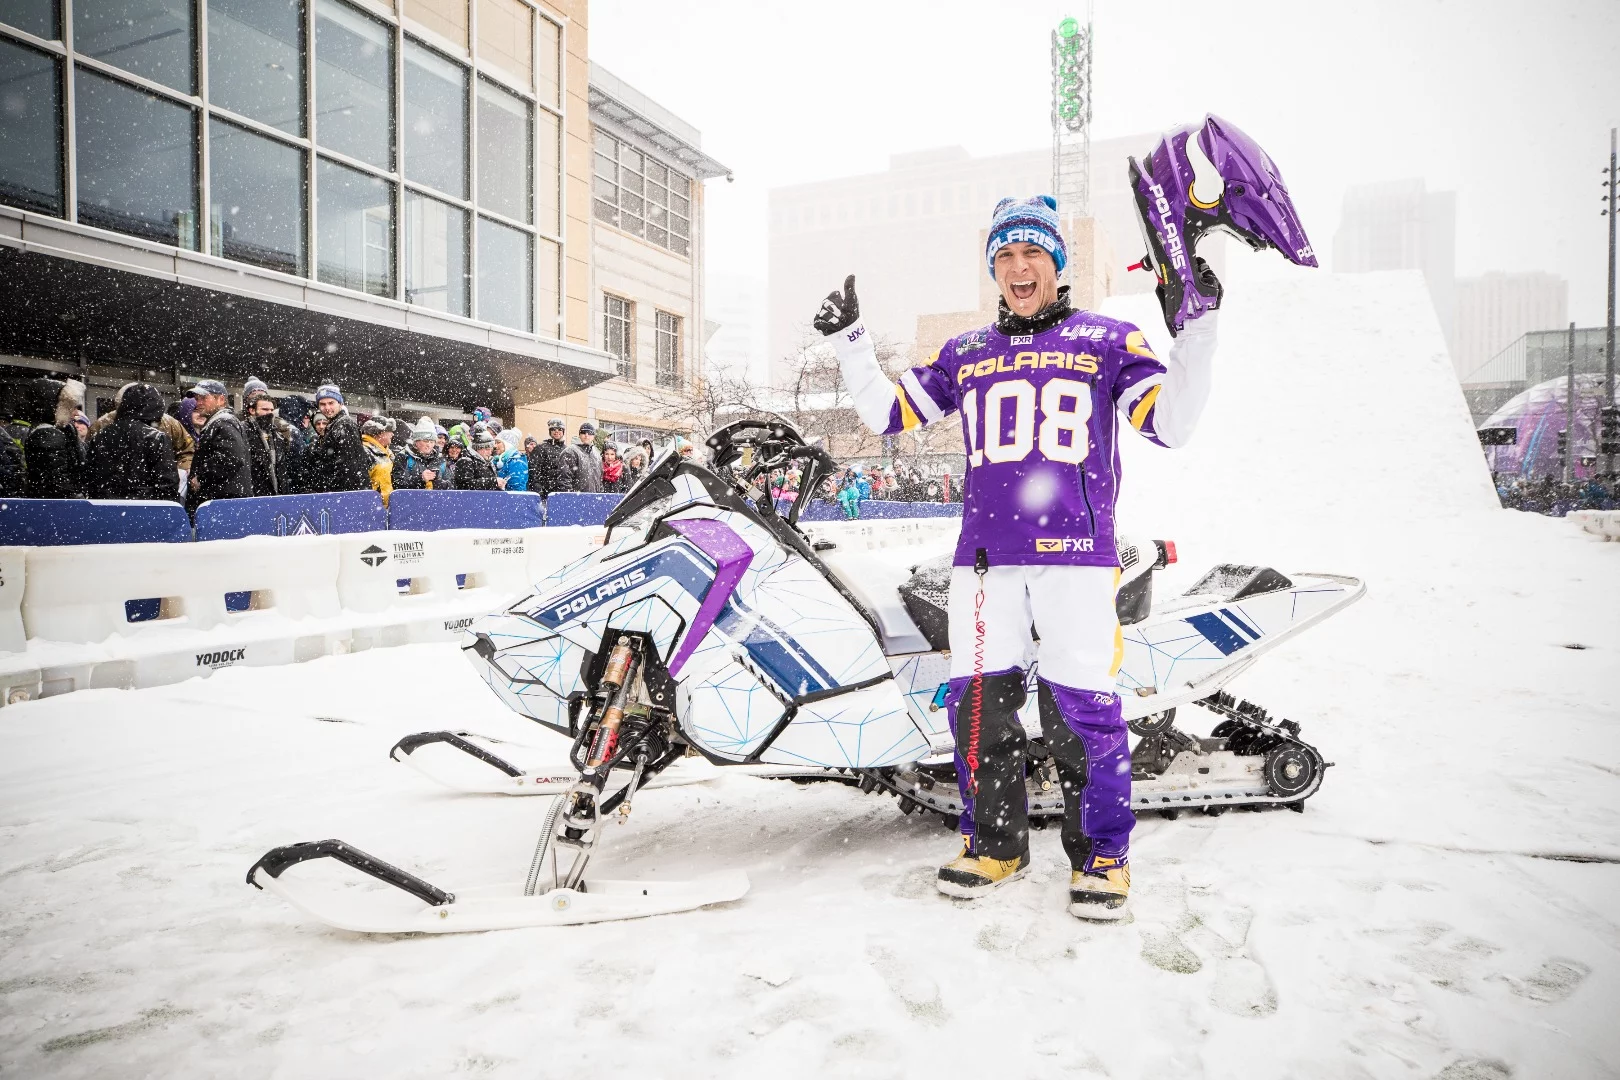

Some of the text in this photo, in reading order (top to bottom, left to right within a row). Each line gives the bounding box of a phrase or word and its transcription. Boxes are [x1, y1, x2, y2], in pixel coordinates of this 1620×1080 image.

[1149, 183, 1186, 270] POLARIS
[1012, 336, 1031, 345] FXR
[957, 352, 1099, 385] POLARIS
[963, 377, 1093, 468] 108
[393, 542, 424, 551] TRINITY
[1062, 539, 1094, 552] FXR
[555, 567, 646, 620] POLARIS
[444, 617, 474, 630] YODOCK
[196, 648, 246, 666] YODOCK
